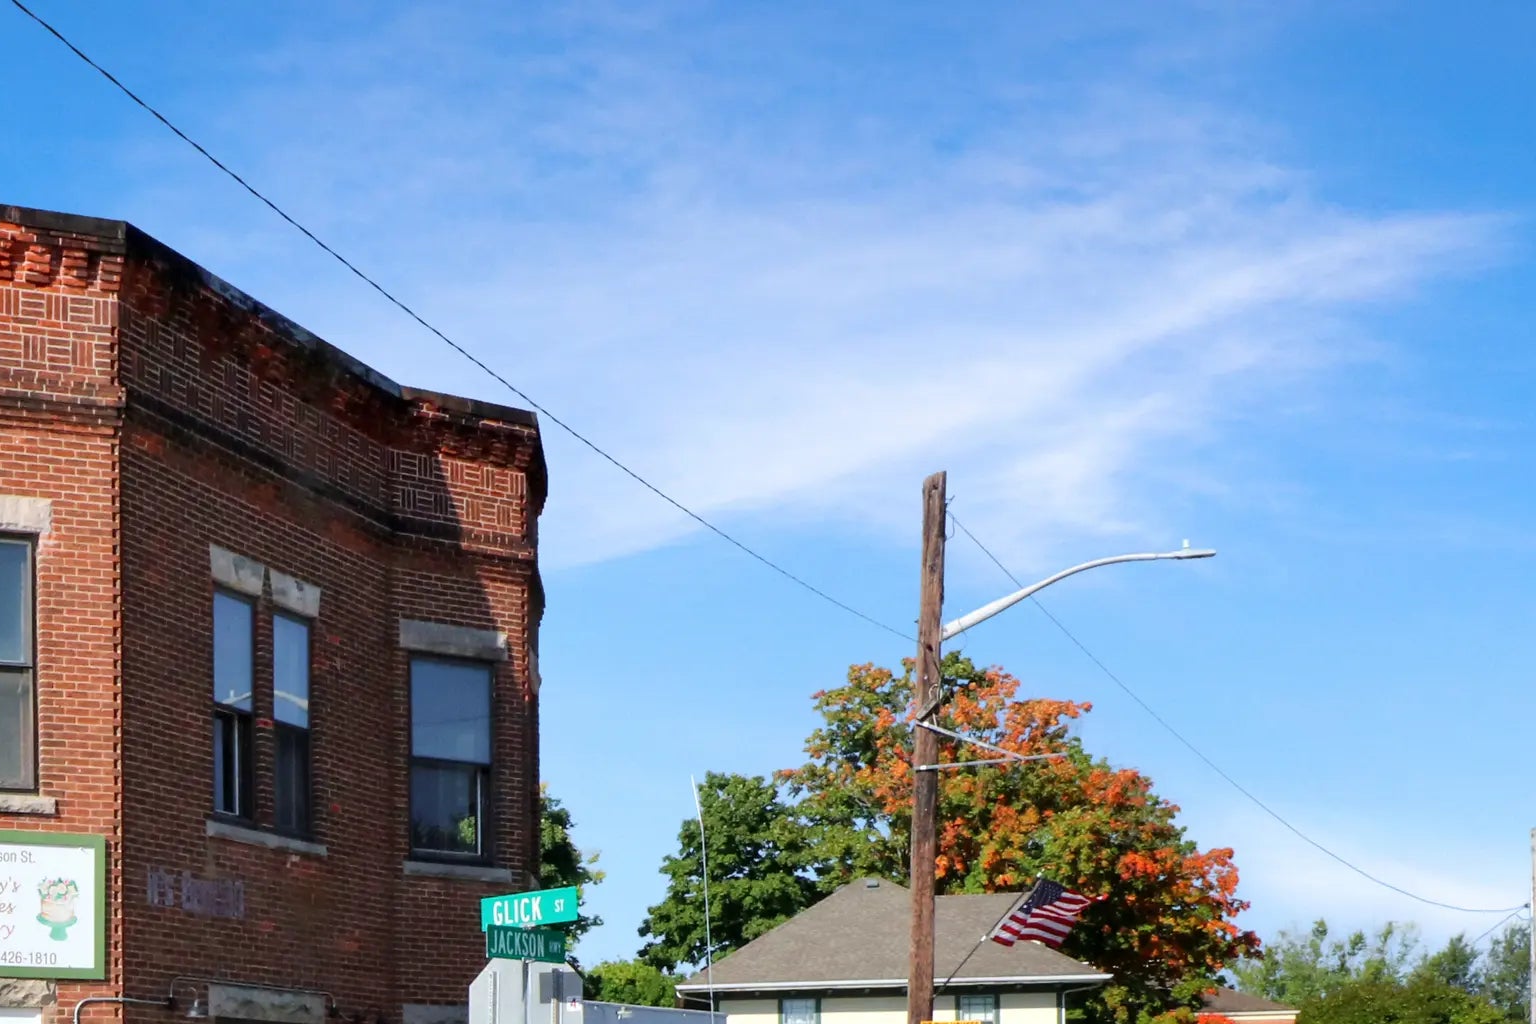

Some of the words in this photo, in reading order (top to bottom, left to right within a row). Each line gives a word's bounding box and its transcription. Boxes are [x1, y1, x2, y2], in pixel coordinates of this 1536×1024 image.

[20, 850, 36, 863] St.
[492, 895, 542, 926] GLICK
[554, 899, 565, 913] ST
[490, 930, 545, 957] JACKSON
